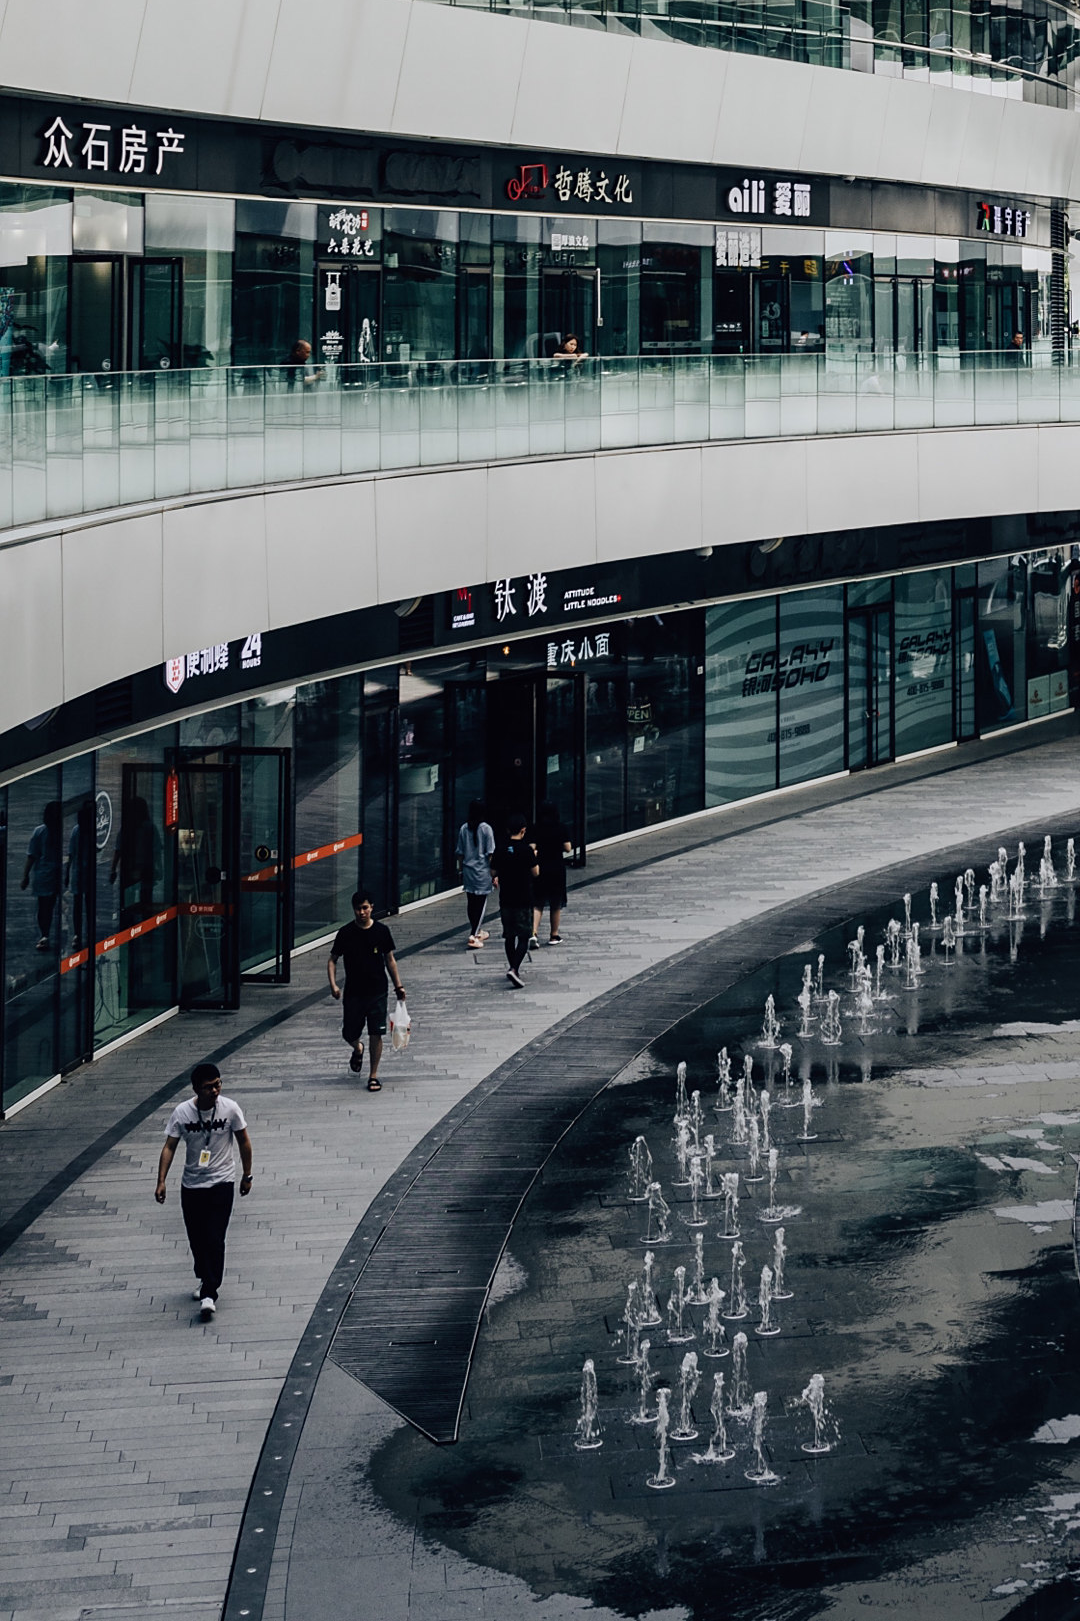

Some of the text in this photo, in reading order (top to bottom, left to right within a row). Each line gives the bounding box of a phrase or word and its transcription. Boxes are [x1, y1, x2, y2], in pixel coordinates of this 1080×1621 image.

[43, 116, 186, 176] 众石房产
[554, 165, 633, 204] 哲腾文化
[728, 178, 811, 217] aili 爱丽
[563, 586, 595, 600] ATTITUDE
[563, 594, 618, 612] LITTLE NOODLES
[241, 633, 262, 660] 24
[546, 632, 611, 667] 重庆小面
[242, 656, 261, 670] HOURS
